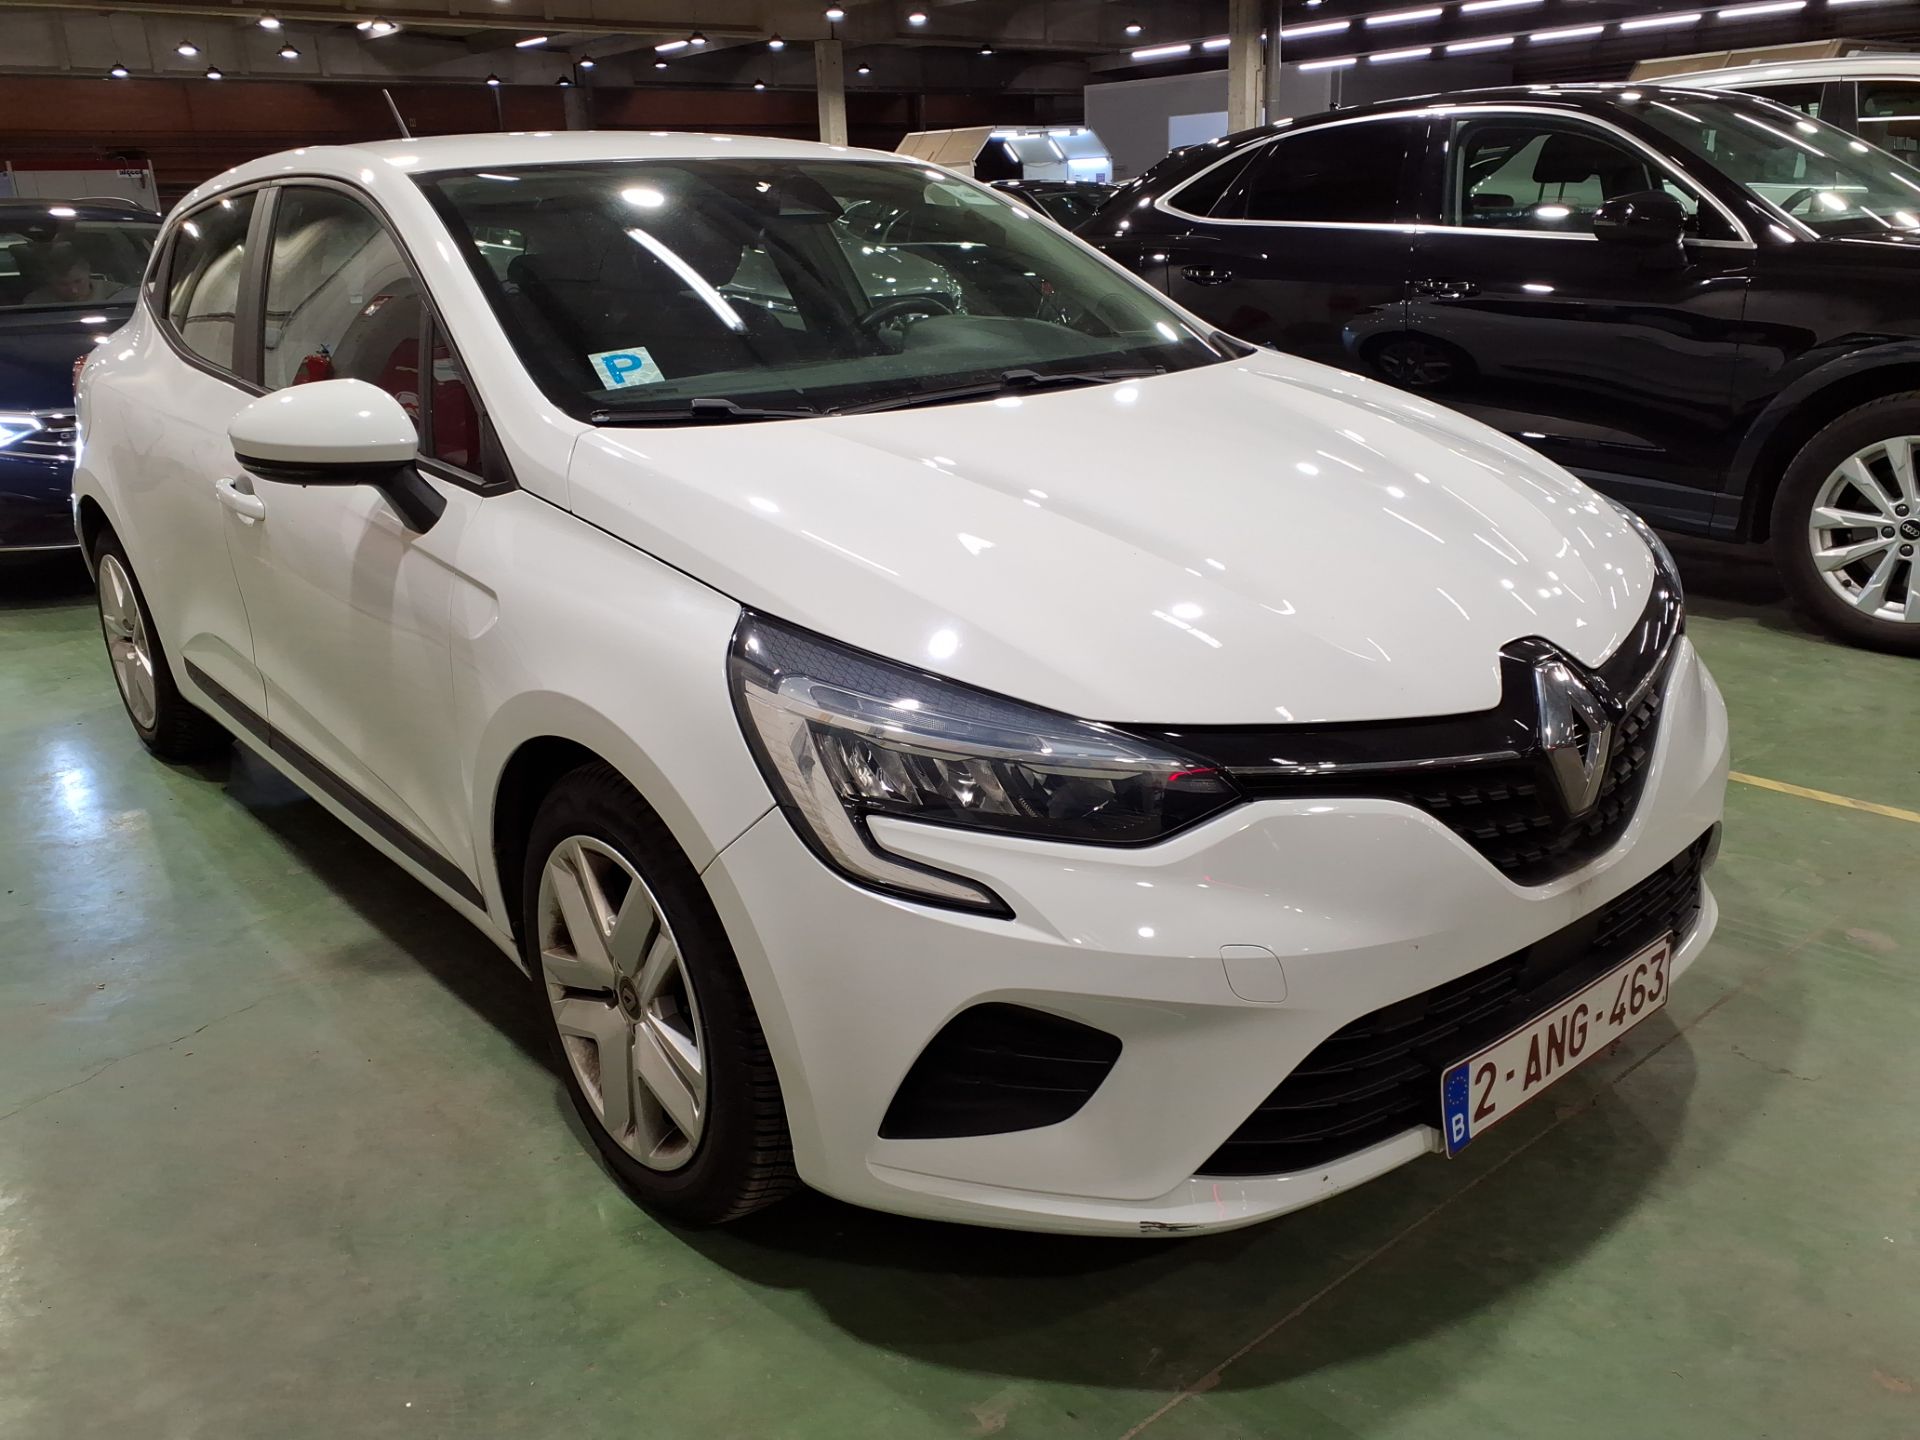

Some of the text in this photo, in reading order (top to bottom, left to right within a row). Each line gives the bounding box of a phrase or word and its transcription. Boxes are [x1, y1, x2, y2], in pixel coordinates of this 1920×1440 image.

[601, 353, 643, 385] P
[1473, 948, 1667, 1124] 2-ANG-463
[1451, 1112, 1465, 1143] B
